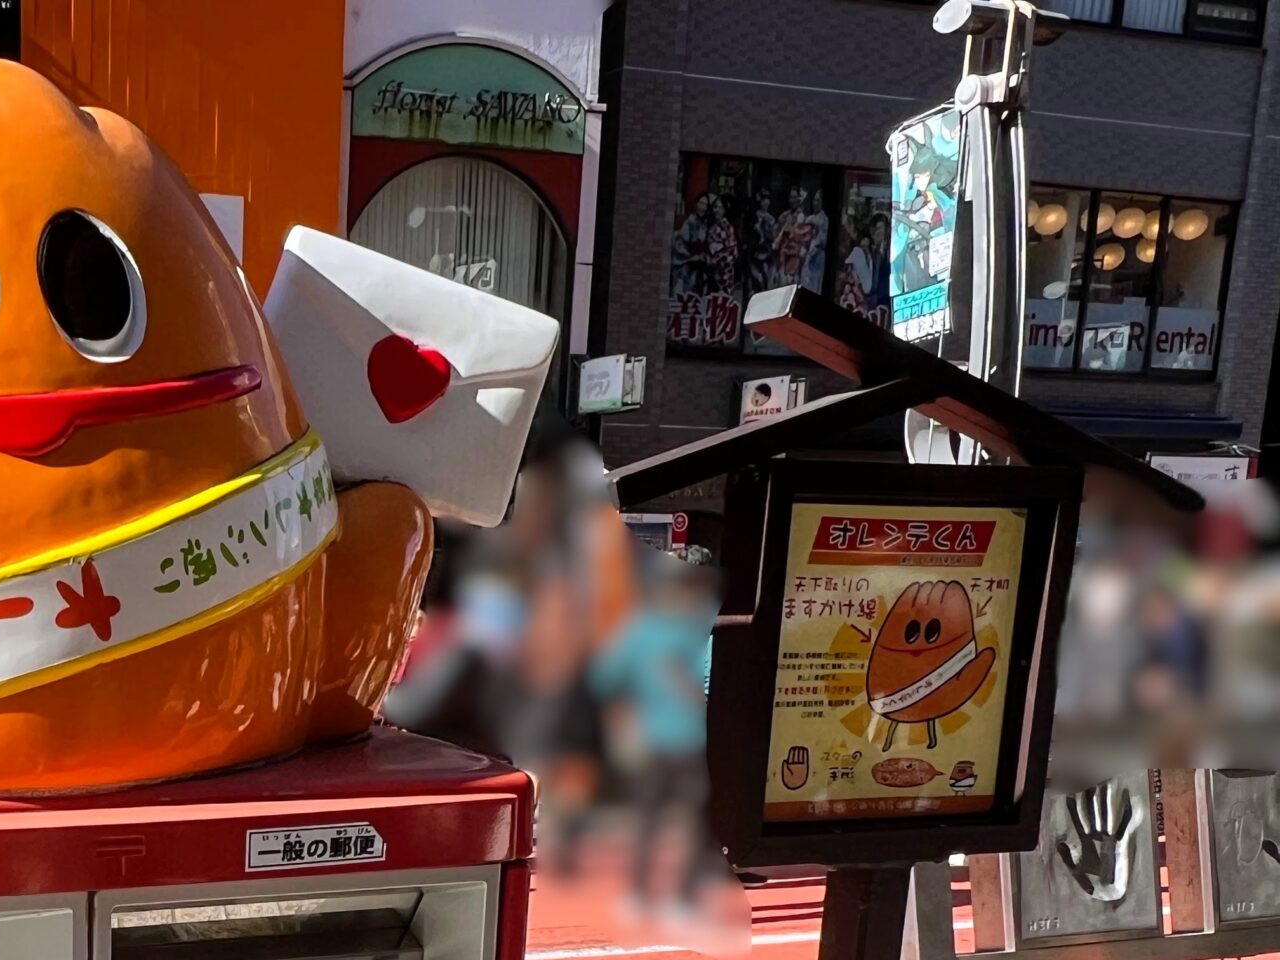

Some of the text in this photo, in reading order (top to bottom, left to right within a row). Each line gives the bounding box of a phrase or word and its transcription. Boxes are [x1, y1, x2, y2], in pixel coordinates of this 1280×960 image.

[463, 88, 583, 124] SAWANO
[667, 292, 741, 342] 着物
[1126, 321, 1216, 357] Rental
[829, 519, 977, 551] オレンテくん
[794, 576, 870, 593] 天下取りの
[784, 597, 877, 620] ますかけ線
[258, 835, 376, 862] 一般の郵便
